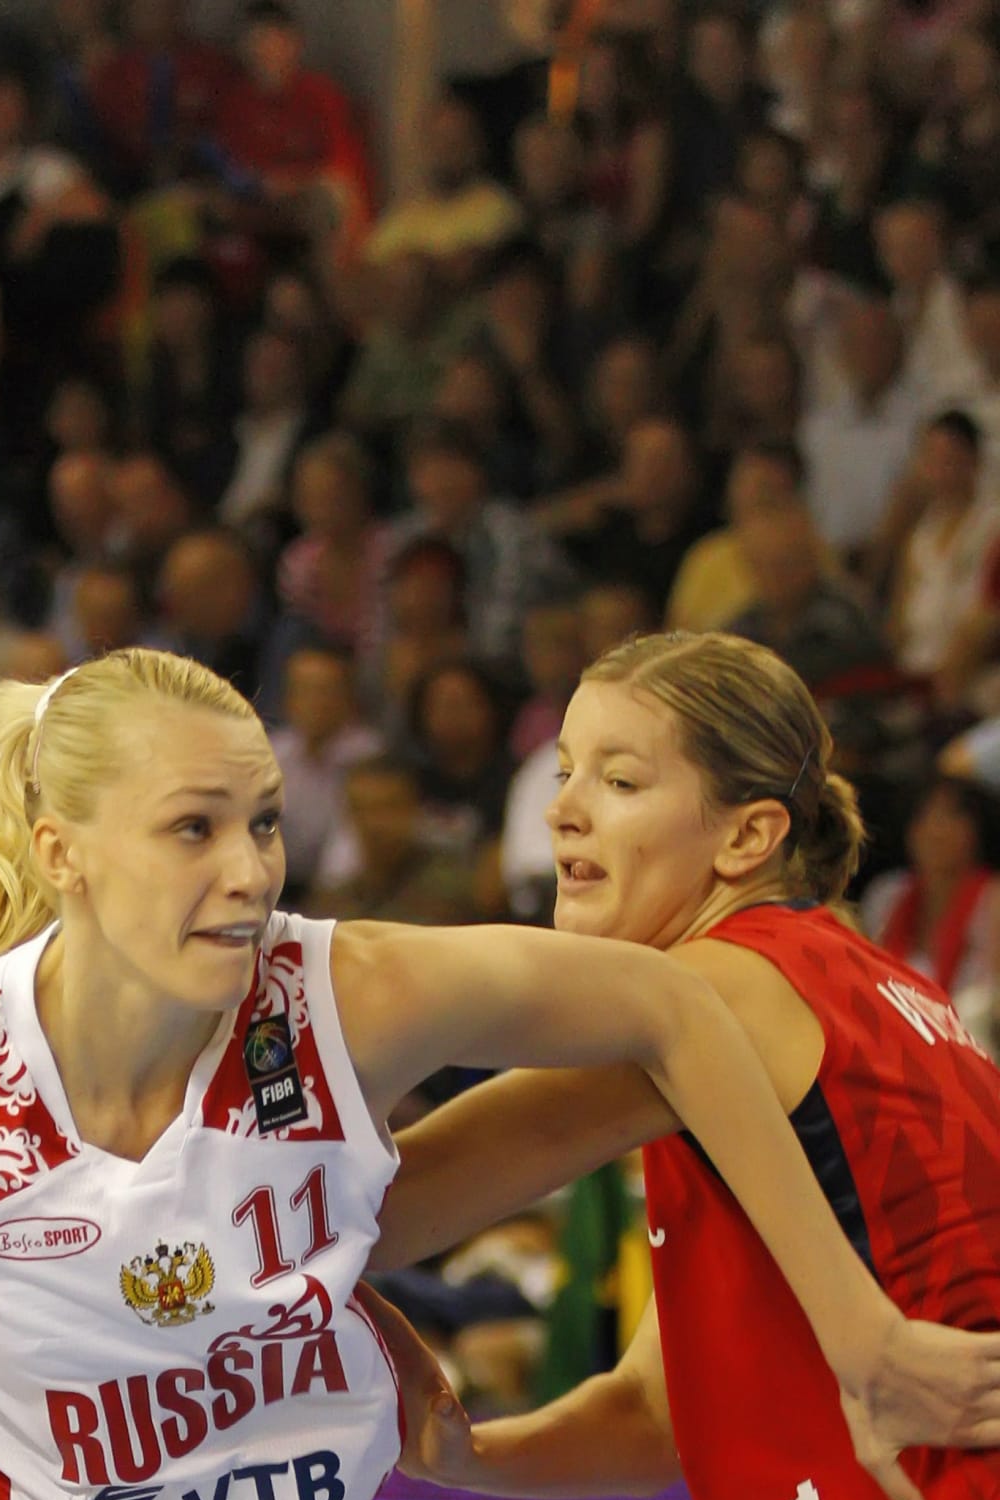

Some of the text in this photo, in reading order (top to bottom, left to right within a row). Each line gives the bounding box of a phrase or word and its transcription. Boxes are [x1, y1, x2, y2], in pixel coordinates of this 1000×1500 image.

[262, 1077, 294, 1107] FIBA
[233, 1164, 339, 1290] 11
[45, 1329, 348, 1486] RUSSIA
